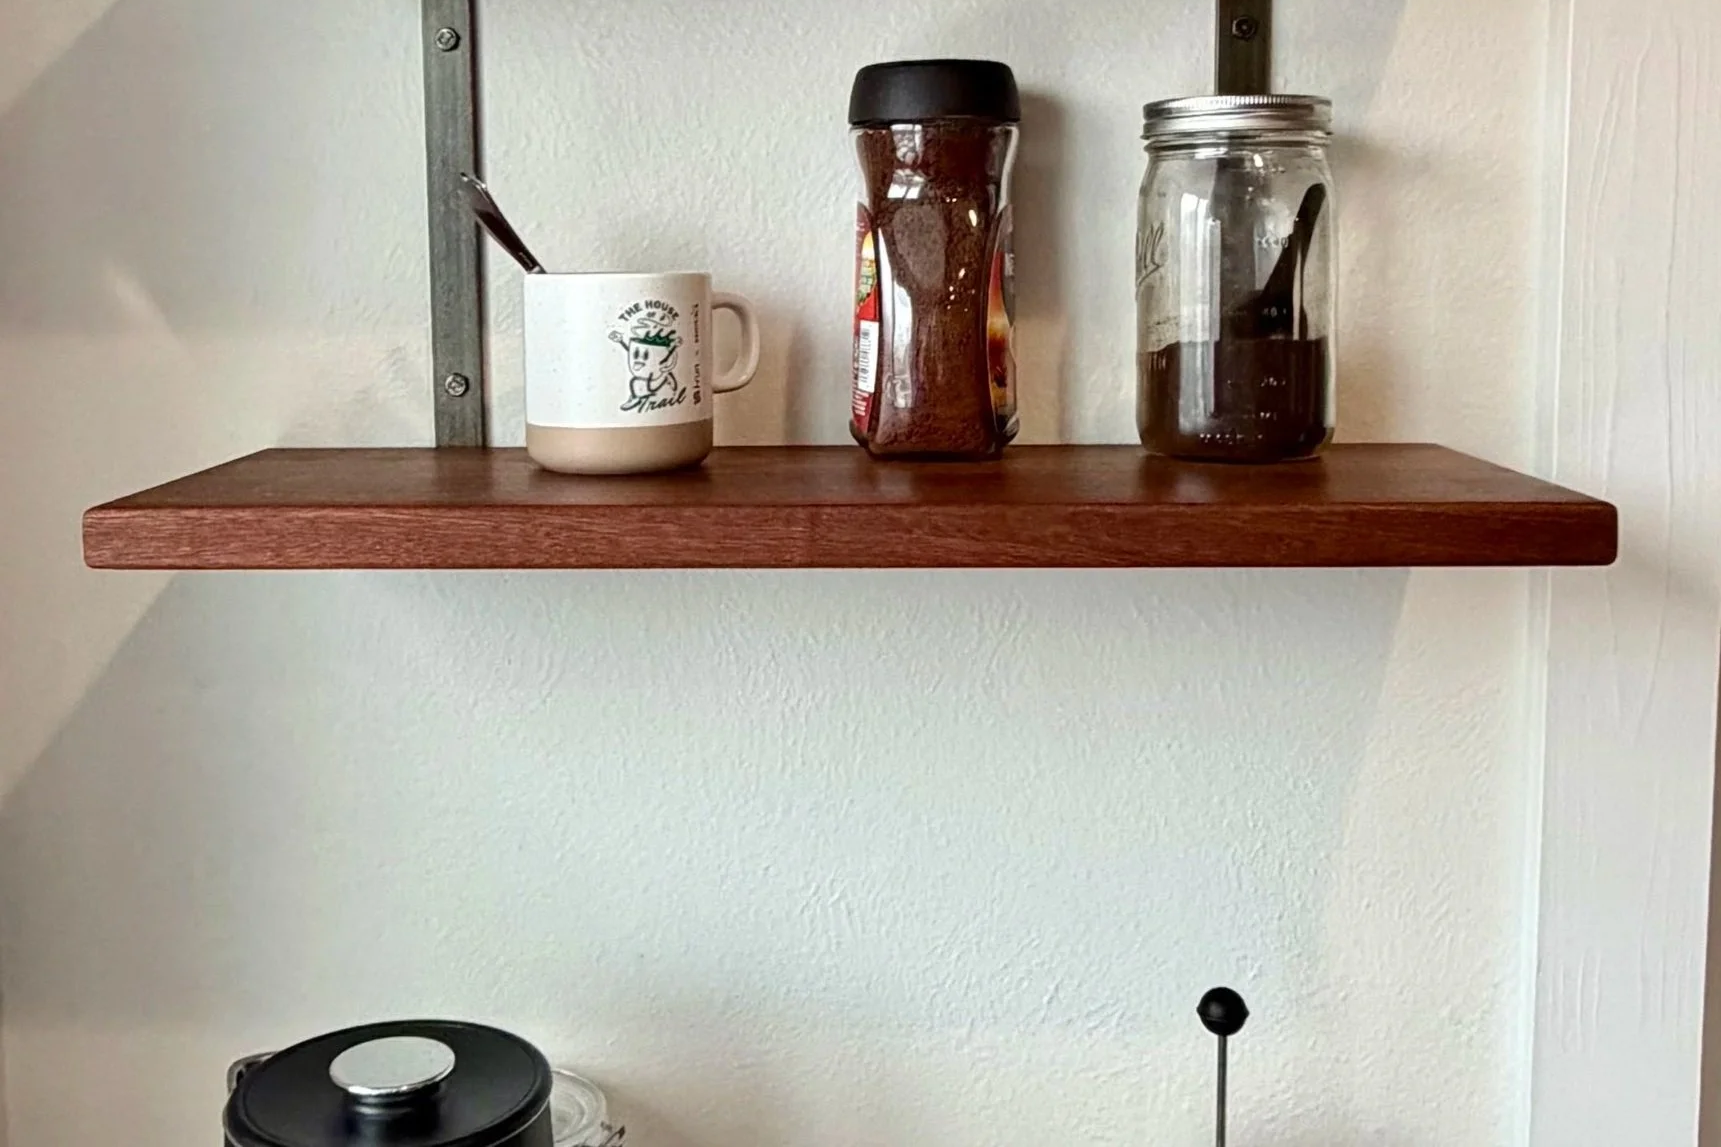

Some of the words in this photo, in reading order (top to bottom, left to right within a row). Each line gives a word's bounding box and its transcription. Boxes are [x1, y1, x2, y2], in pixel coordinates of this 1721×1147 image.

[618, 303, 642, 322] THE
[645, 300, 679, 321] HOUSE
[637, 387, 687, 413] Trail
